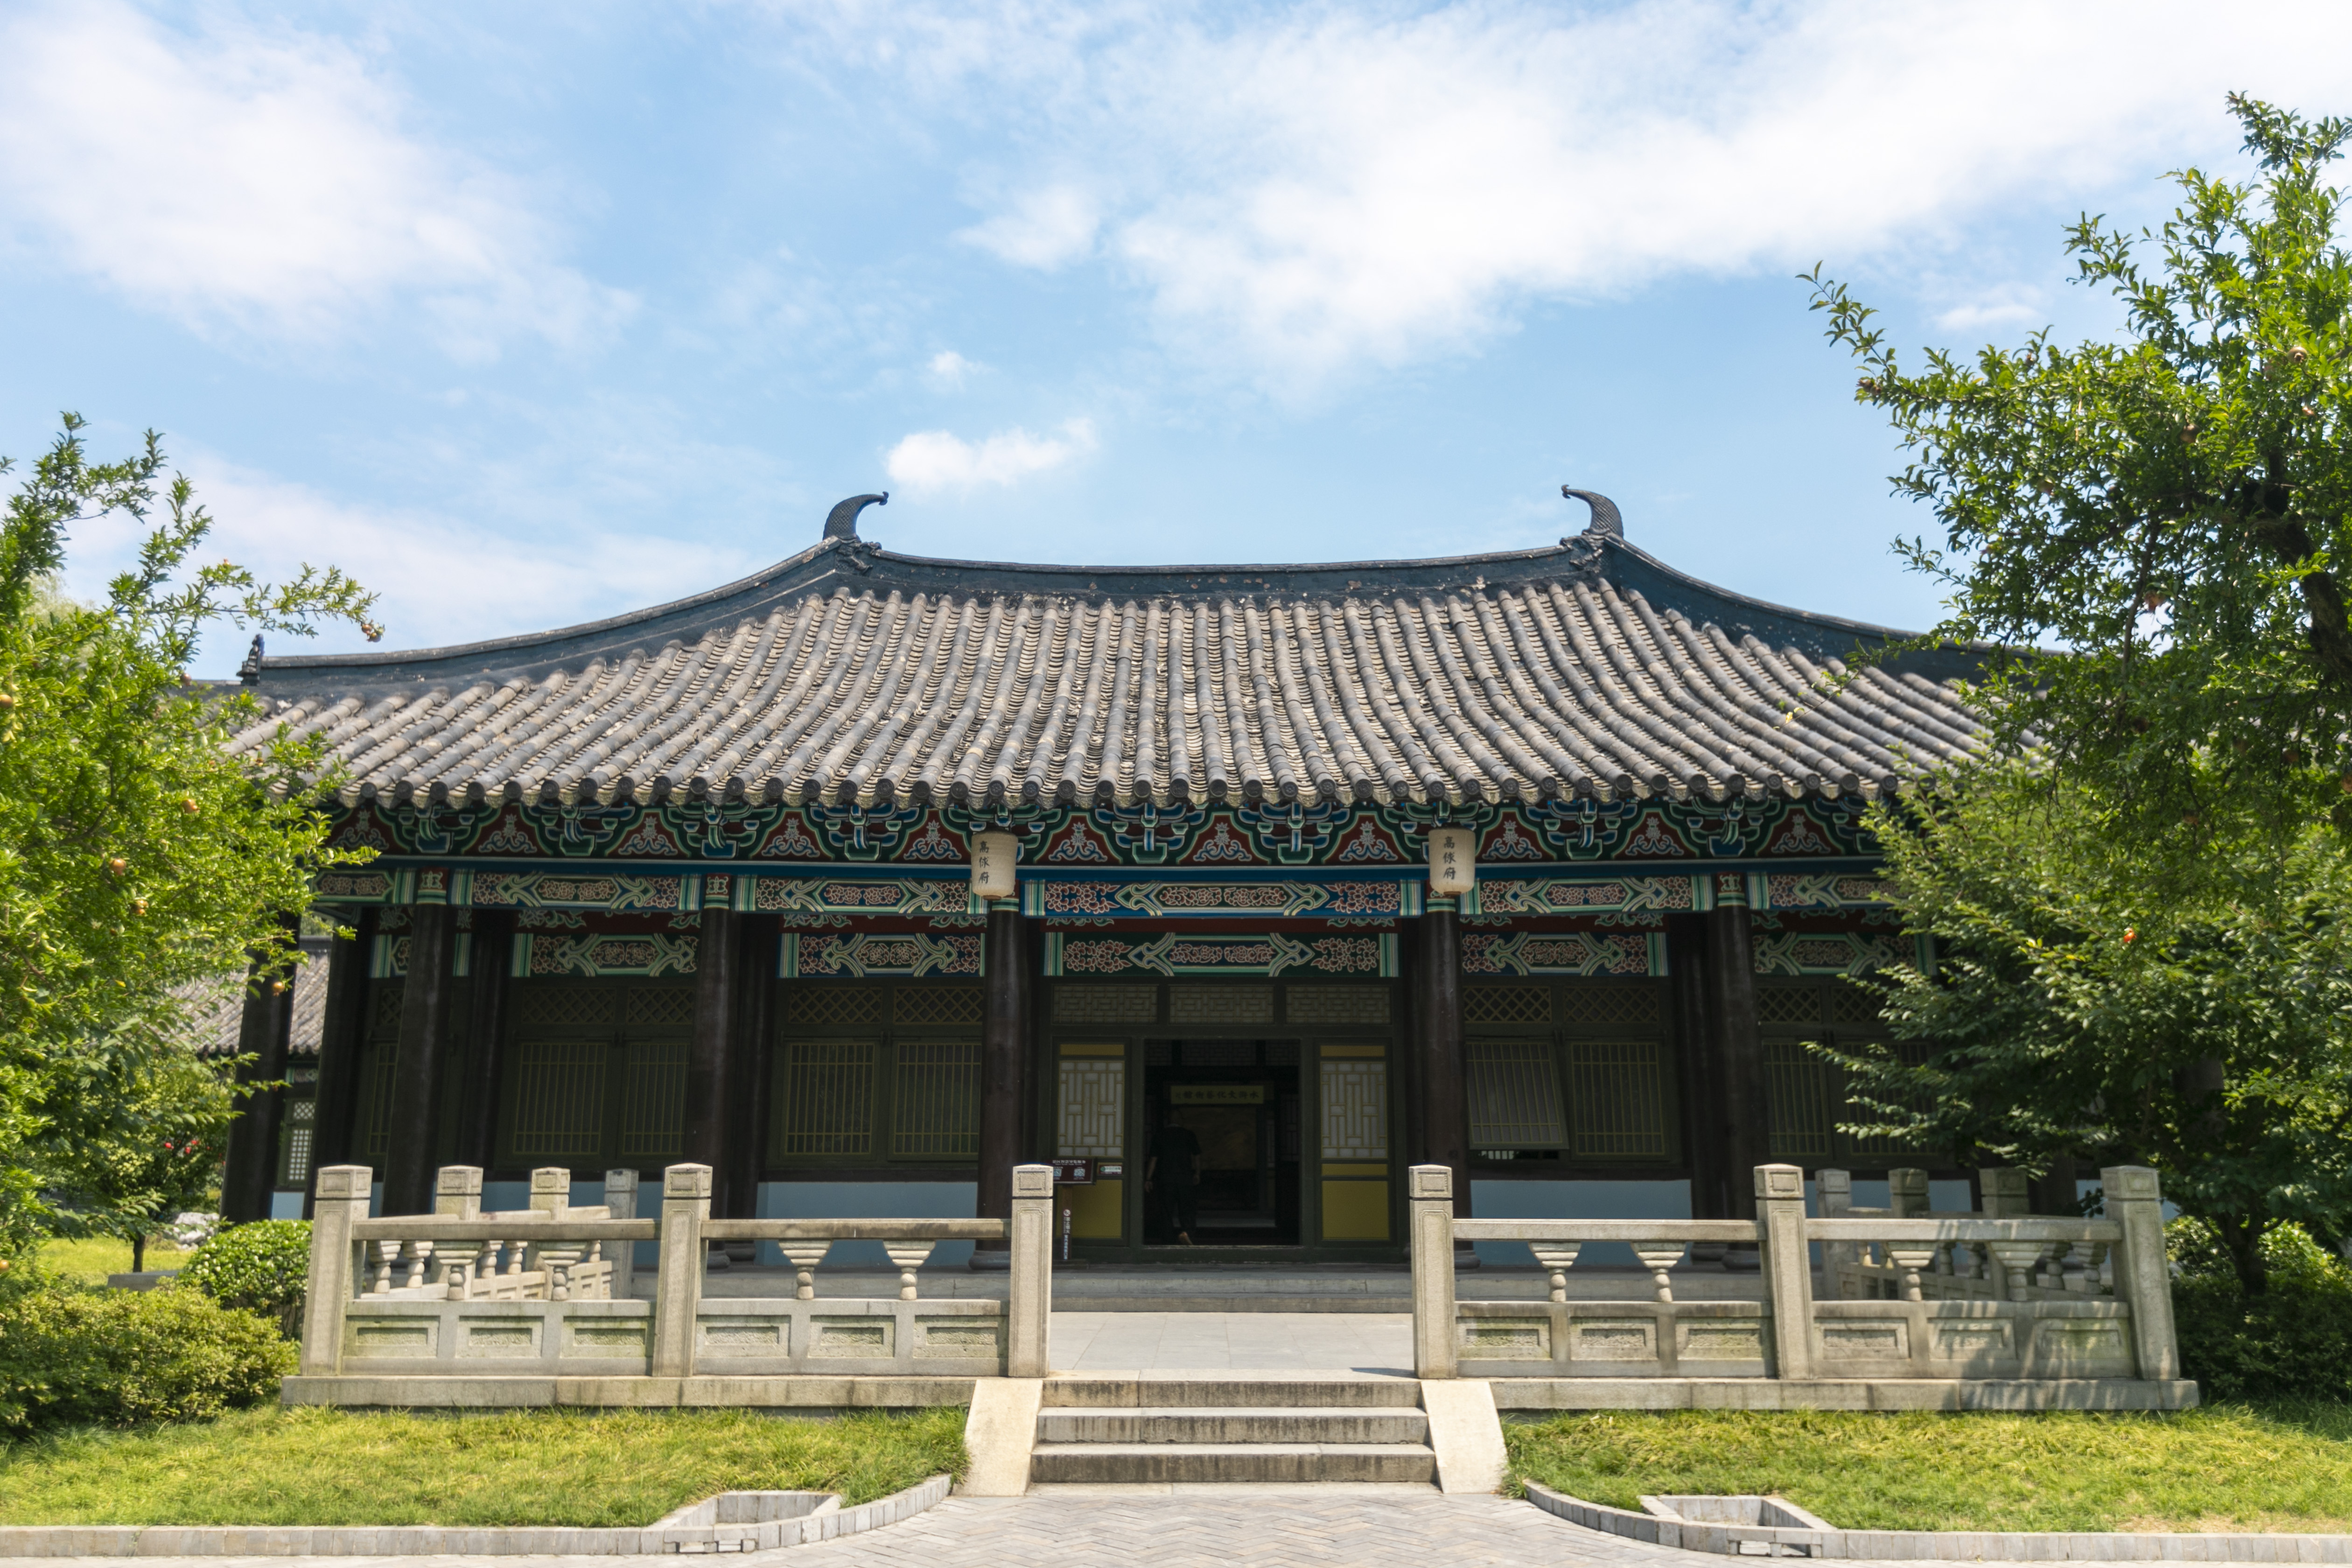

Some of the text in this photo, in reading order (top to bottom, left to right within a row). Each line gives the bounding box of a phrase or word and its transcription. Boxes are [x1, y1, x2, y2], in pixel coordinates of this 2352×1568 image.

[979, 840, 990, 884] 高俅府
[1443, 836, 1456, 880] 高俅府
